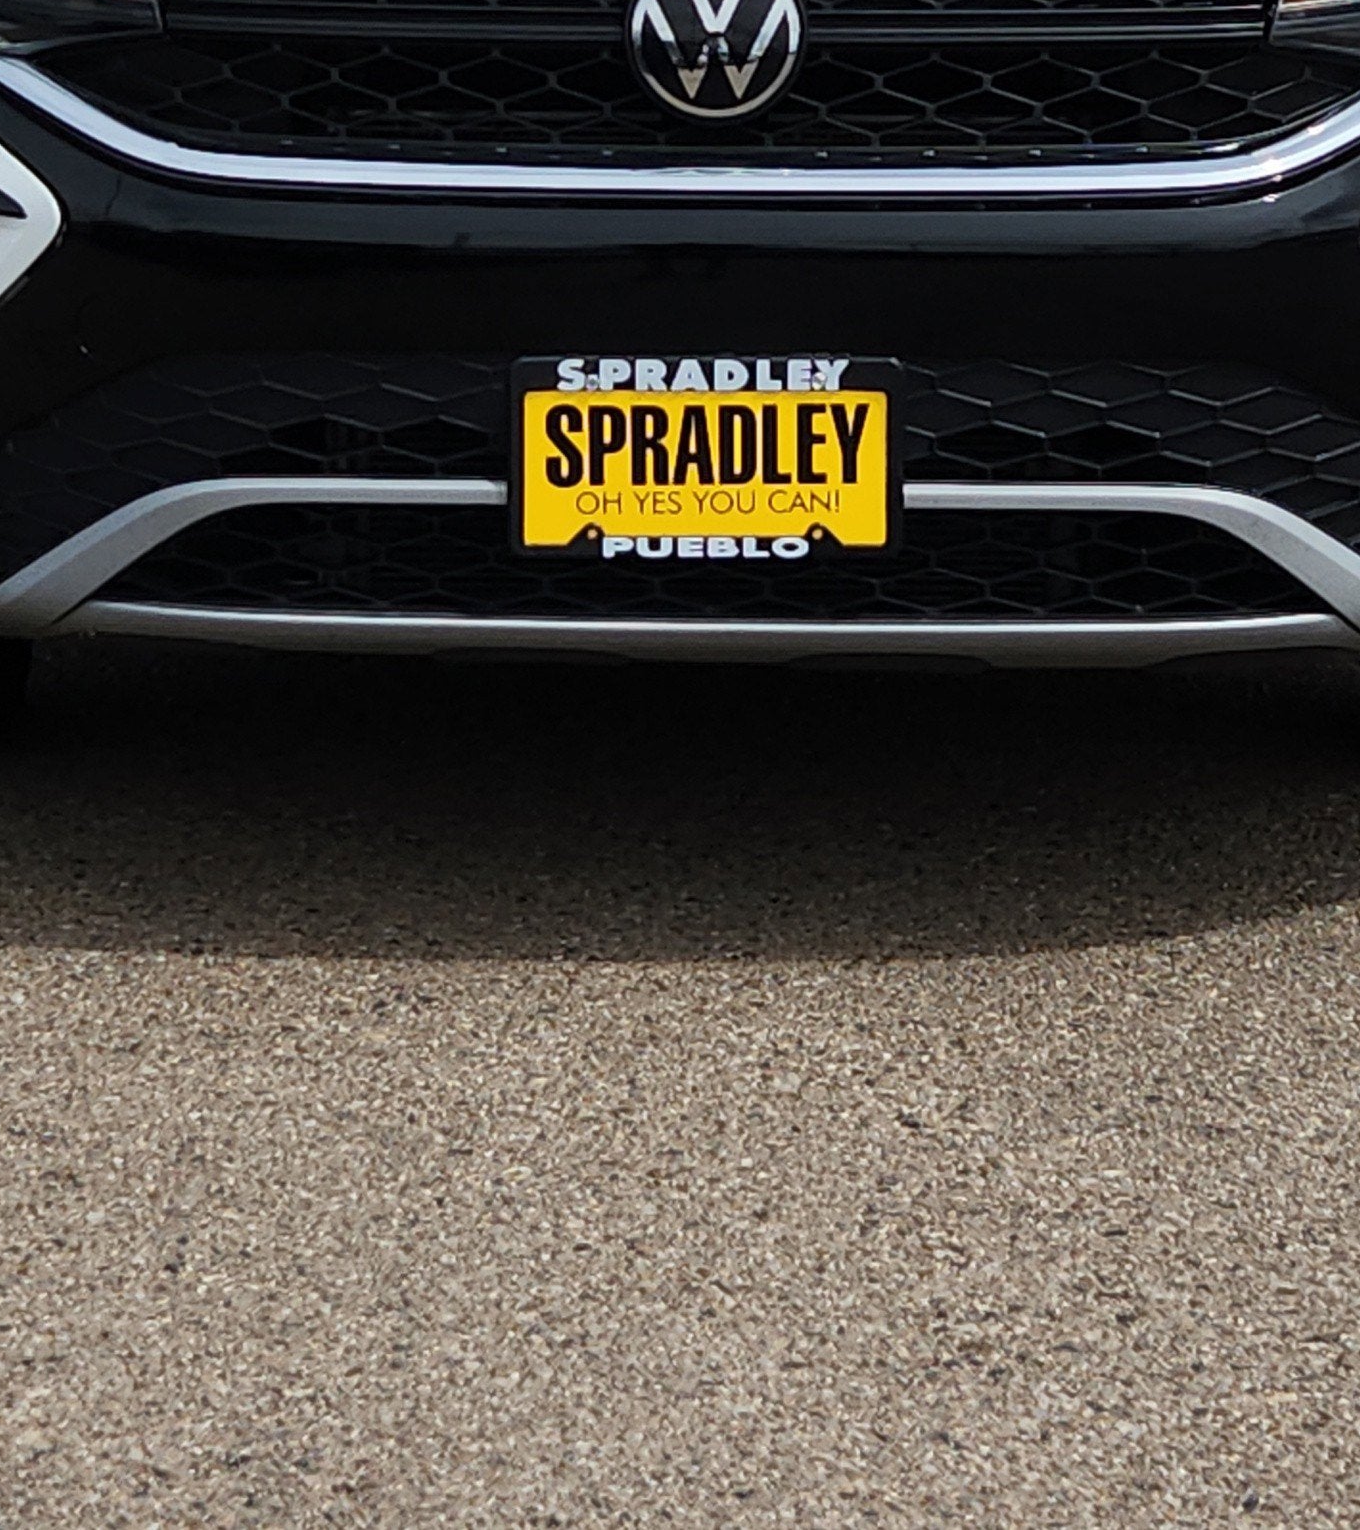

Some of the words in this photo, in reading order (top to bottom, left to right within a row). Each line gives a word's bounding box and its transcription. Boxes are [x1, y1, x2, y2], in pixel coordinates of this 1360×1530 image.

[556, 358, 850, 392] SPRADLEY
[545, 403, 871, 488] SPRADLEY
[575, 490, 622, 515] OH
[632, 490, 683, 515] YES
[693, 490, 756, 515] YOU
[767, 489, 840, 514] CAN!
[602, 536, 810, 559] PUEBLO
